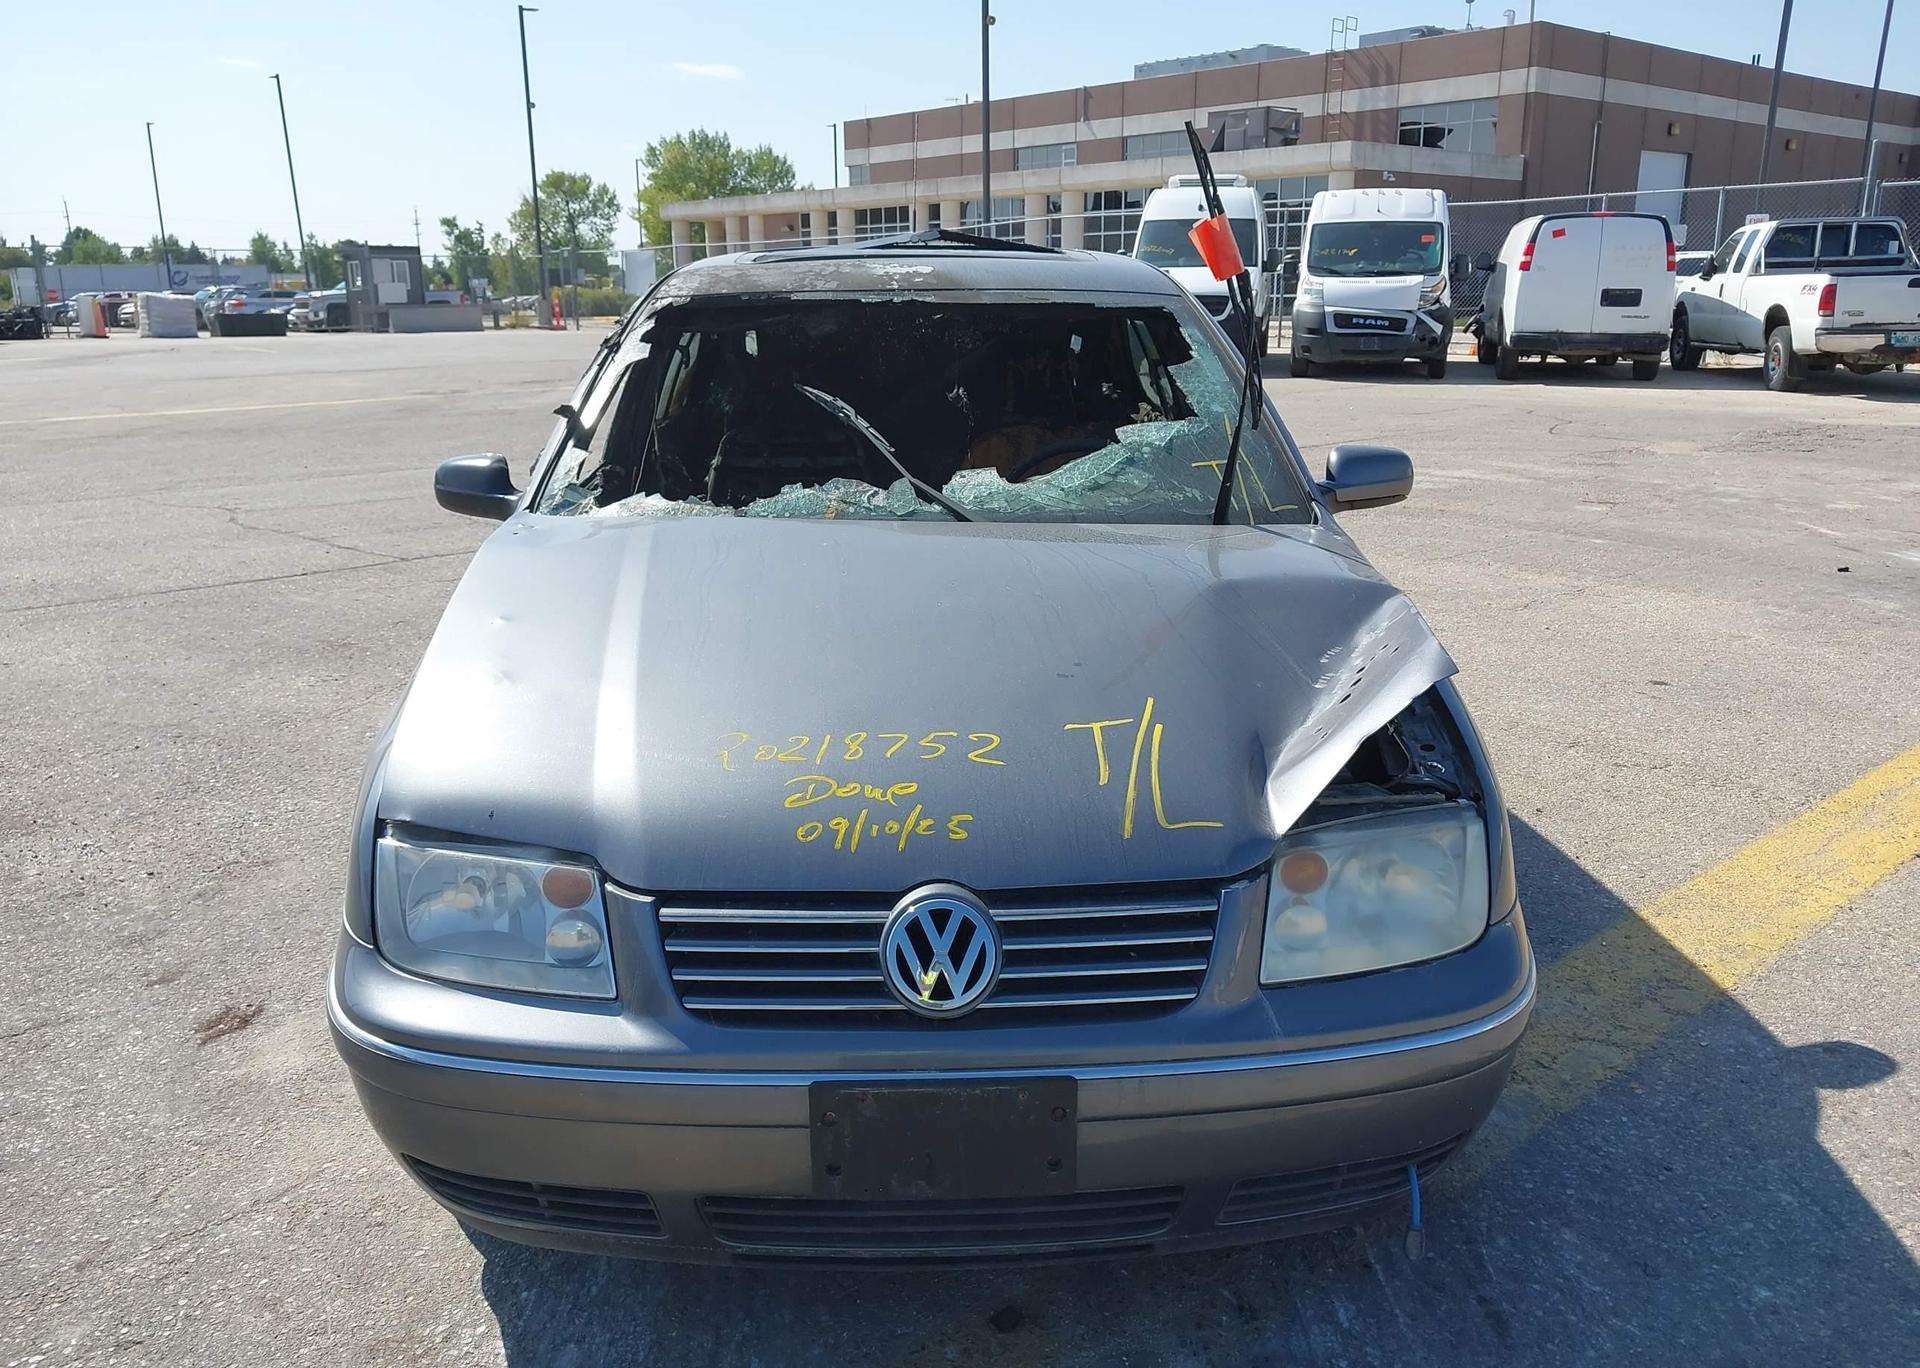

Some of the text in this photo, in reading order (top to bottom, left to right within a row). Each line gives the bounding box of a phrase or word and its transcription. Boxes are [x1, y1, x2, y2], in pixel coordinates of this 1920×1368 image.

[1352, 317, 1389, 327] RAM
[1062, 696, 1222, 839] T/L
[887, 898, 996, 1011] VW
